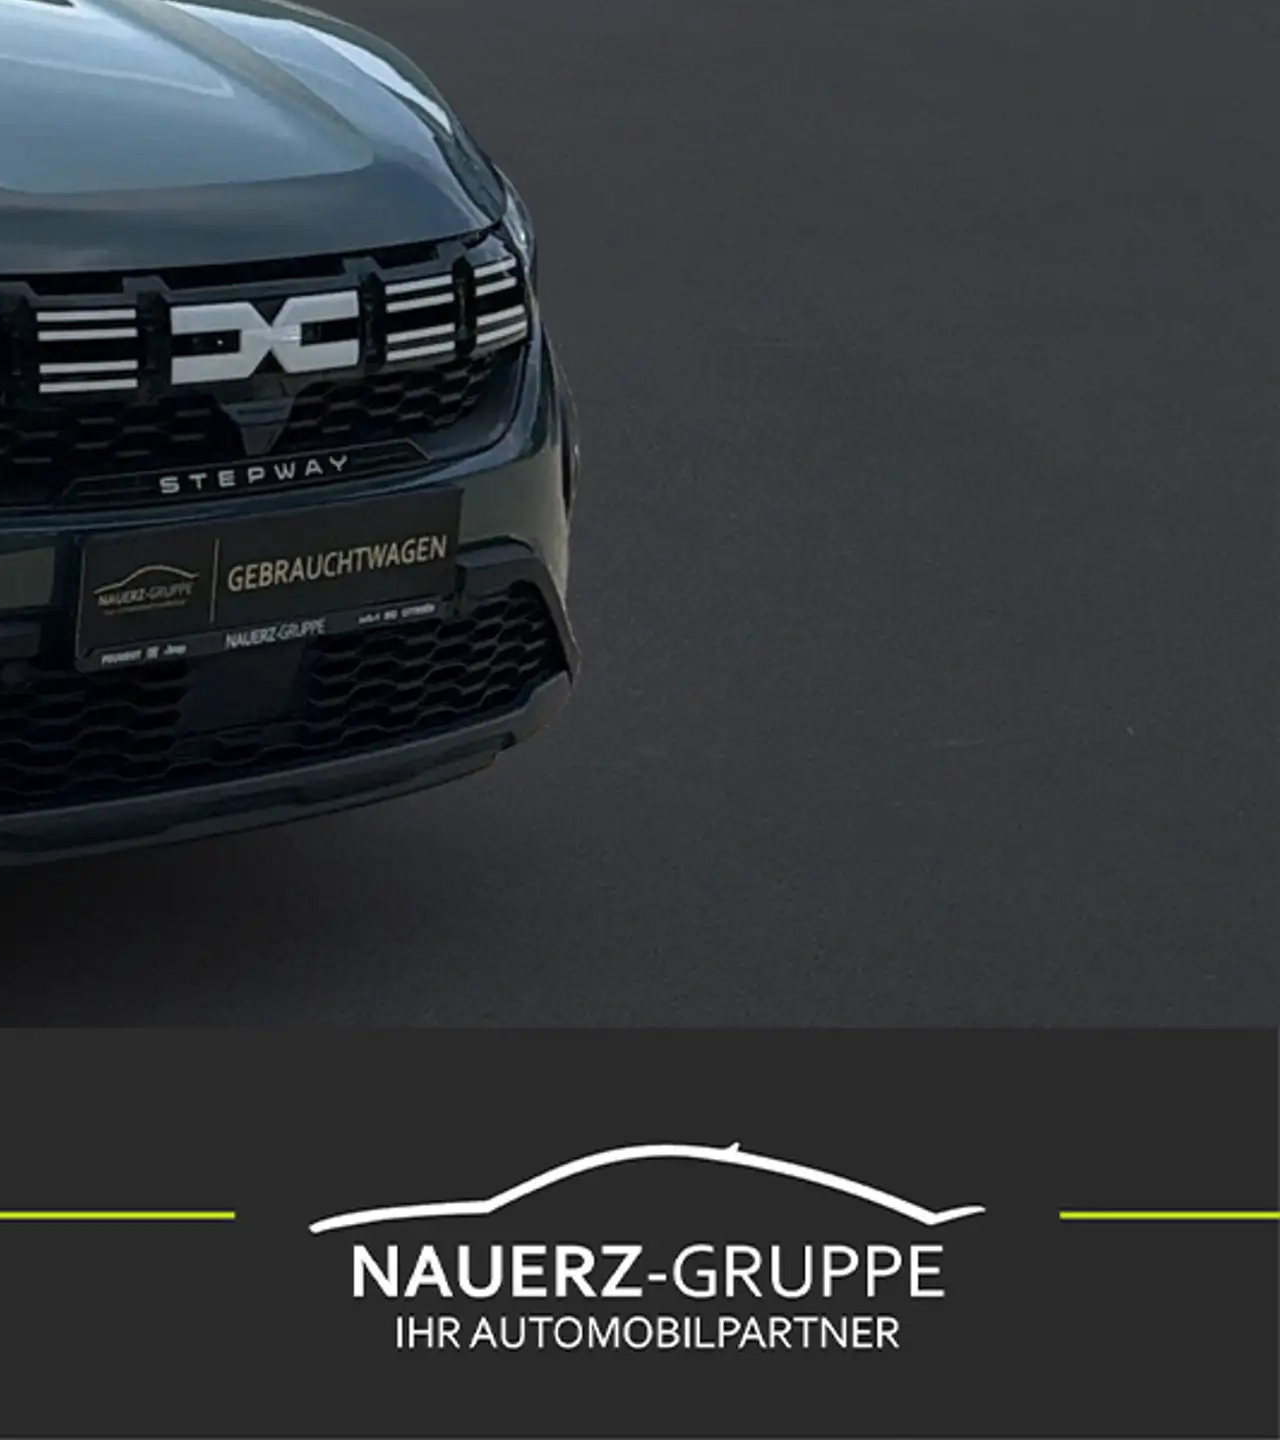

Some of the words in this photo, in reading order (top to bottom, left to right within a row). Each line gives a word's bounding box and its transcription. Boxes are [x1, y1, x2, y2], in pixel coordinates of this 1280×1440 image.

[159, 454, 348, 495] STEPWAY
[226, 534, 448, 592] GEBRAUCHTWAGEN
[224, 617, 326, 650] NAUERZ-GRUPPE
